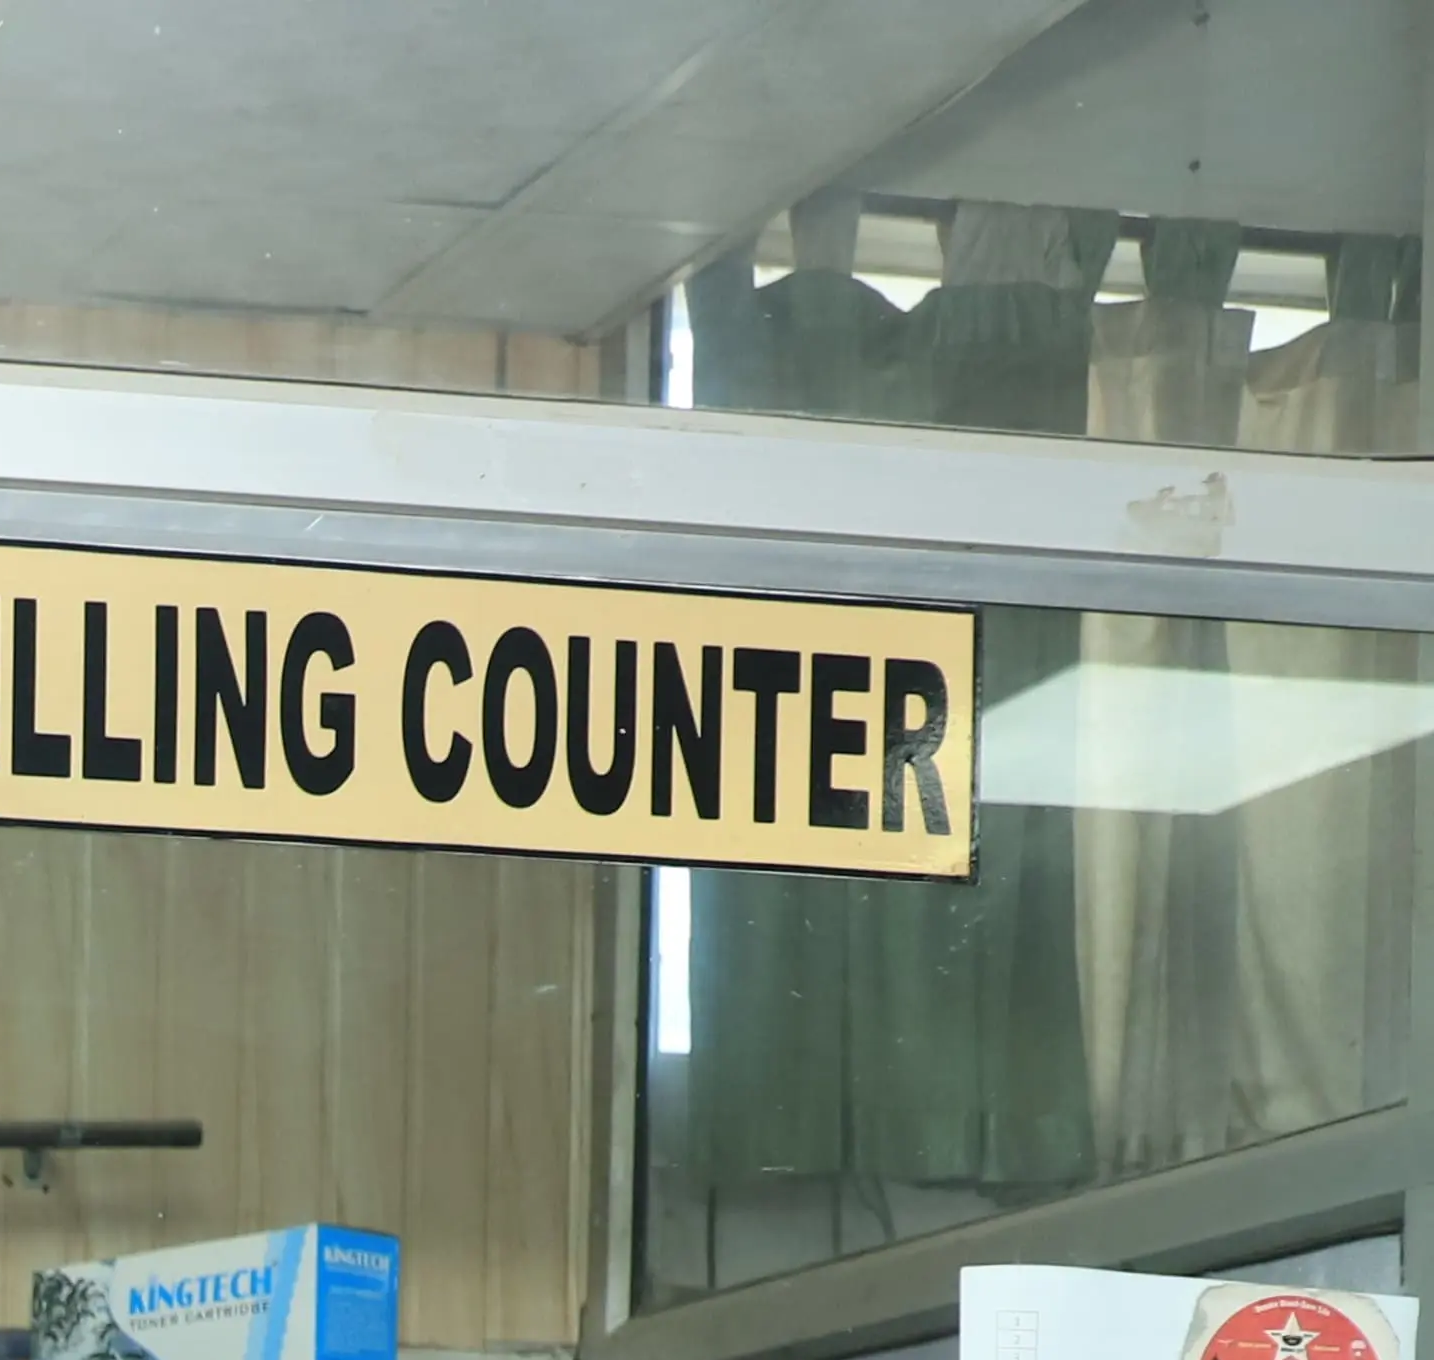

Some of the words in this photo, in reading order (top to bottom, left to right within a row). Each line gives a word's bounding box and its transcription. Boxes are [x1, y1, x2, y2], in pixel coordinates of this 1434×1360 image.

[401, 620, 951, 835] COUNTER
[129, 1265, 273, 1315] KINGTECH
[129, 1316, 179, 1331] TONER
[185, 1301, 270, 1326] CARTRIDGE
